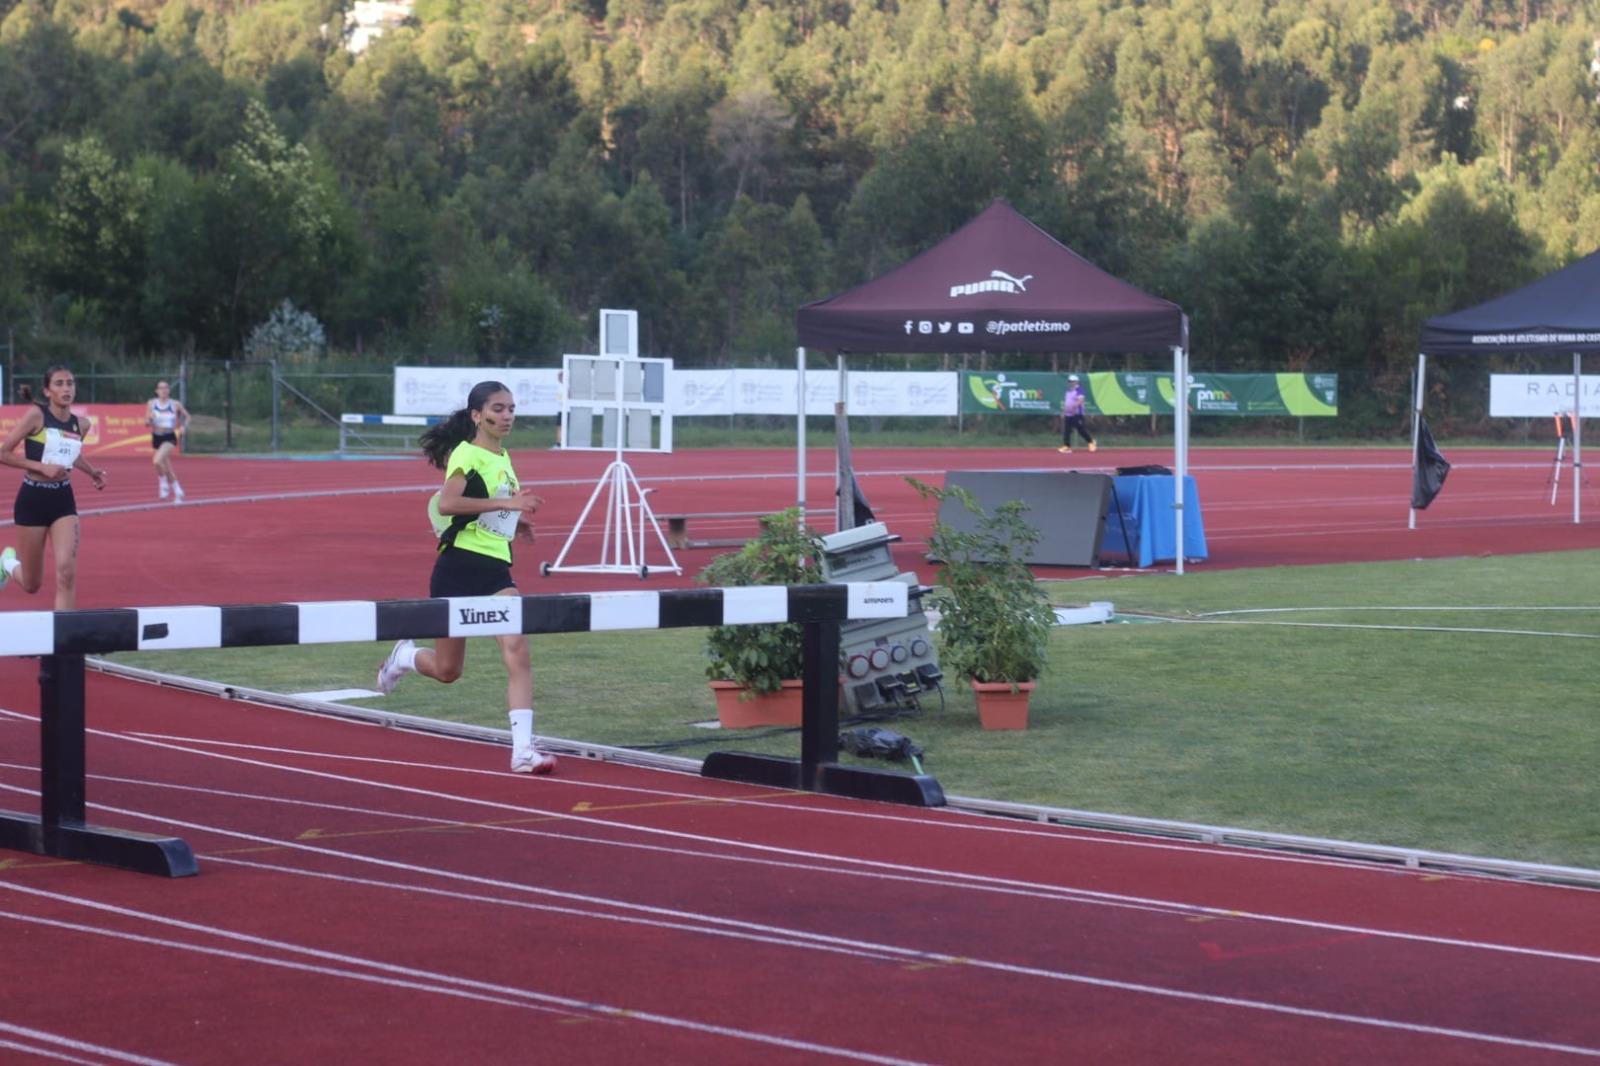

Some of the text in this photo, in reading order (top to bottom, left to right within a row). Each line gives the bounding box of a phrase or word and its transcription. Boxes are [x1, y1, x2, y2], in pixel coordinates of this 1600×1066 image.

[950, 279, 1014, 298] PUMA
[986, 319, 1071, 335] @fpatletismo
[459, 607, 510, 625] Vinex
